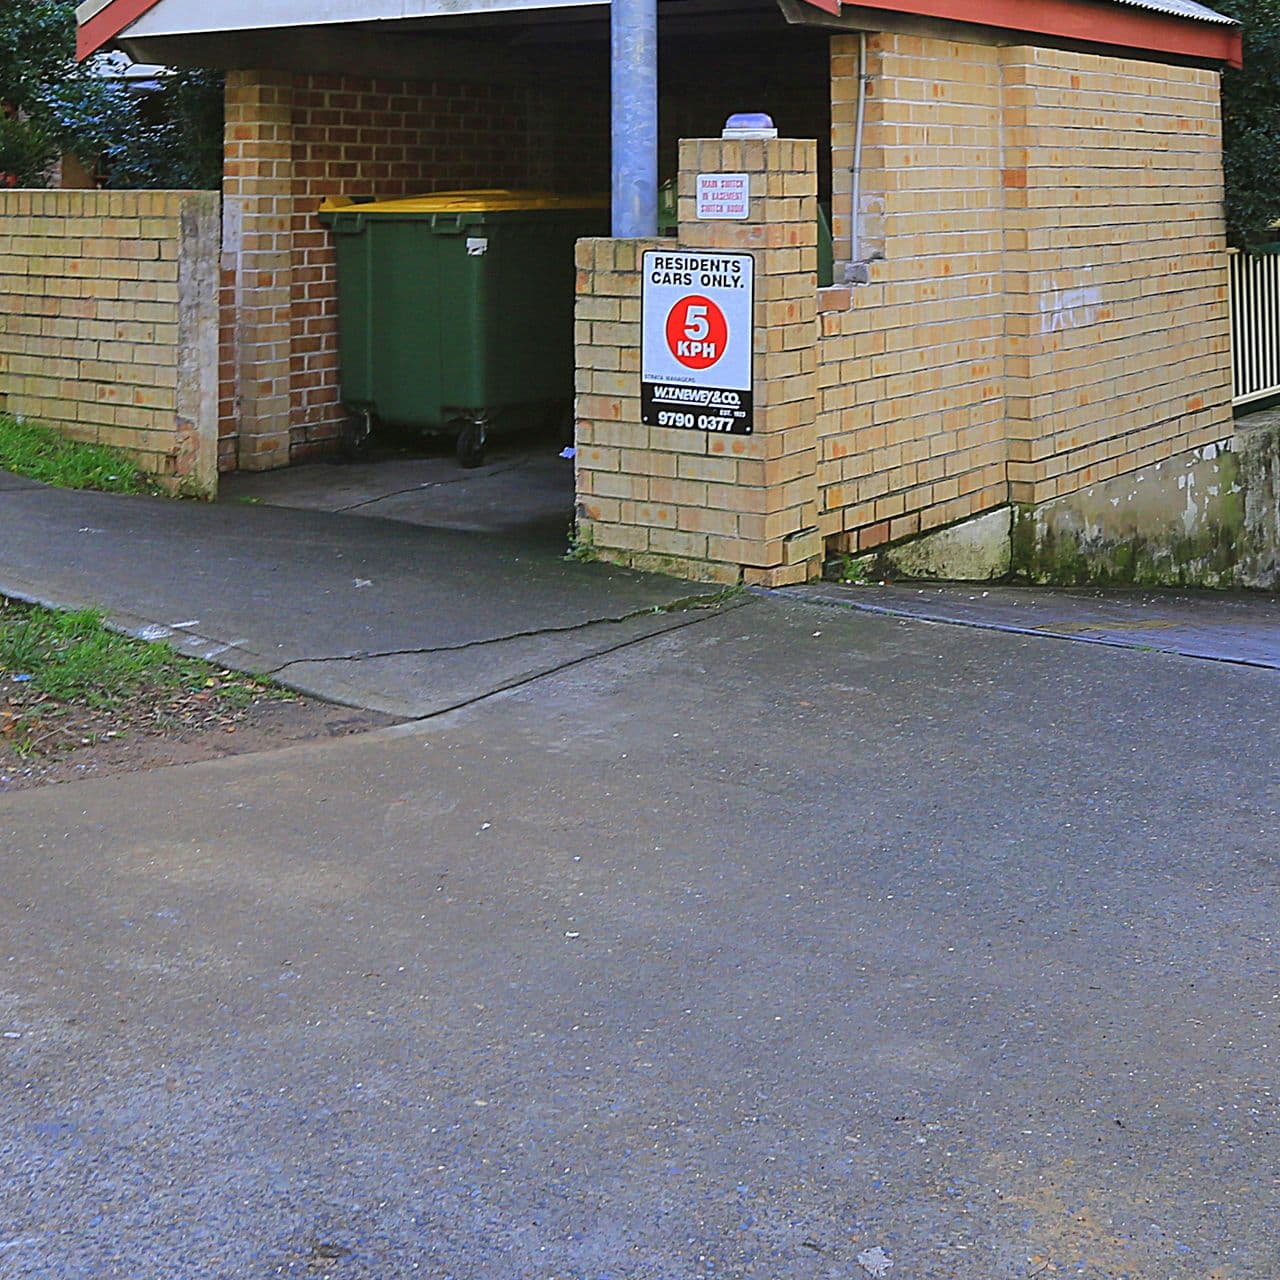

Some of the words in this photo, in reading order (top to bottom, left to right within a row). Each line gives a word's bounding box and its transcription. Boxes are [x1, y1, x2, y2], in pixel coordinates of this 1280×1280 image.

[655, 257, 740, 273] RESIDENTS
[651, 271, 692, 286] CARS
[701, 274, 744, 288] ONLY.
[684, 305, 709, 340] 5
[677, 341, 716, 358] KPH
[658, 411, 694, 427] 9790
[698, 415, 734, 431] 0377
